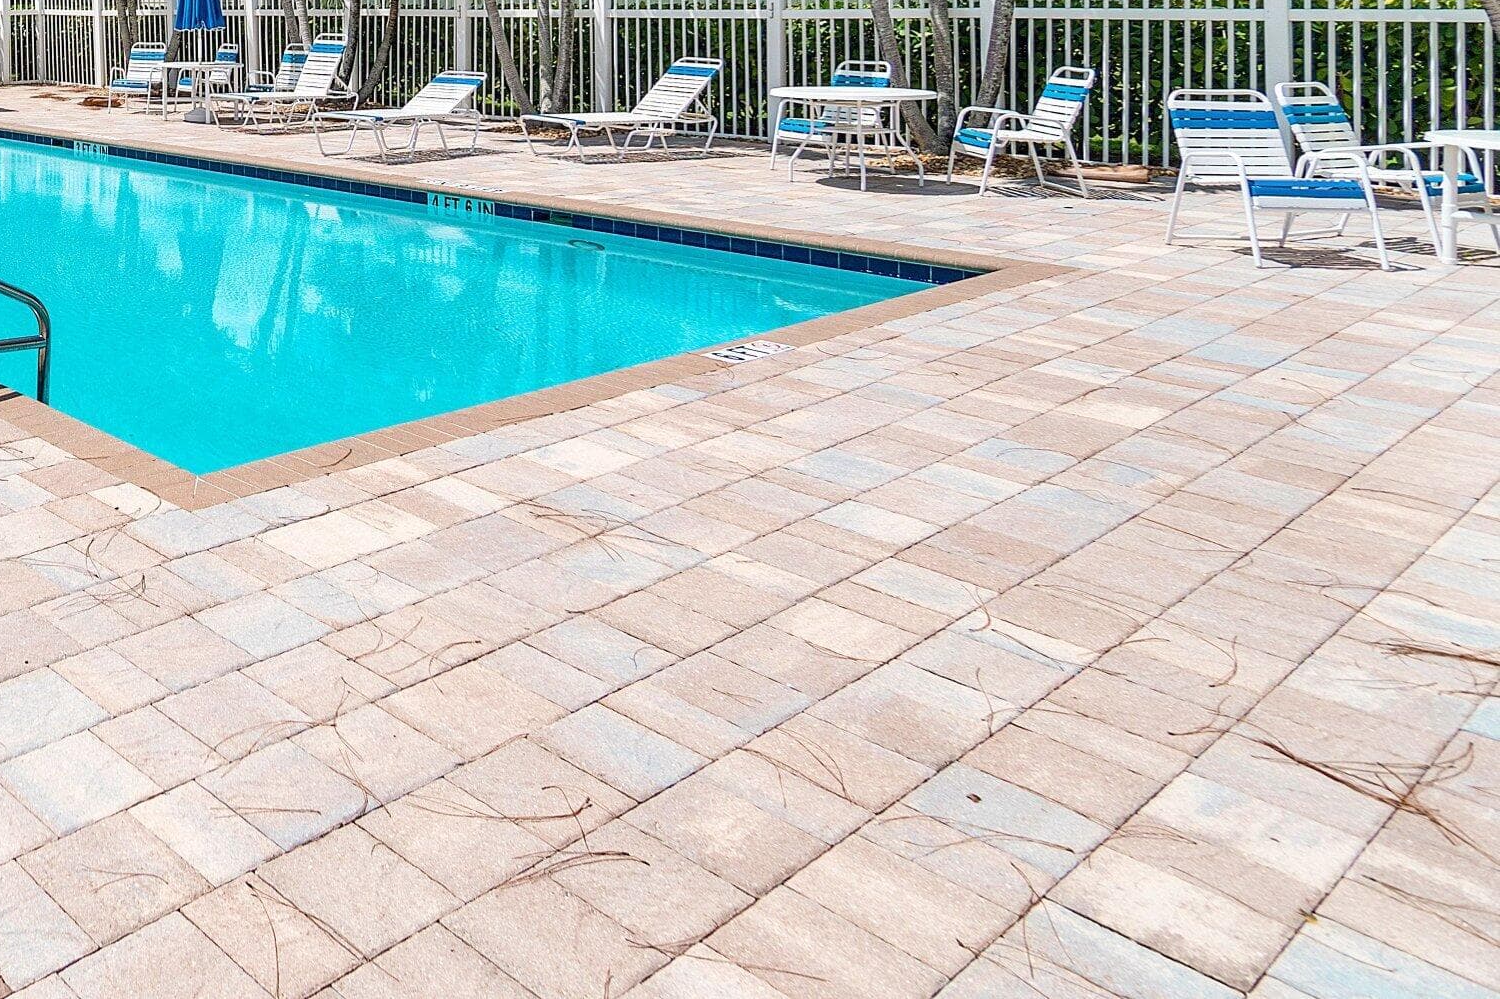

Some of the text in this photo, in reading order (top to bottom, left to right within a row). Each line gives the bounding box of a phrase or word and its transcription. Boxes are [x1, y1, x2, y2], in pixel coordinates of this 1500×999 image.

[432, 194, 493, 215] 4 FT 6 IN
[726, 345, 771, 358] FT
